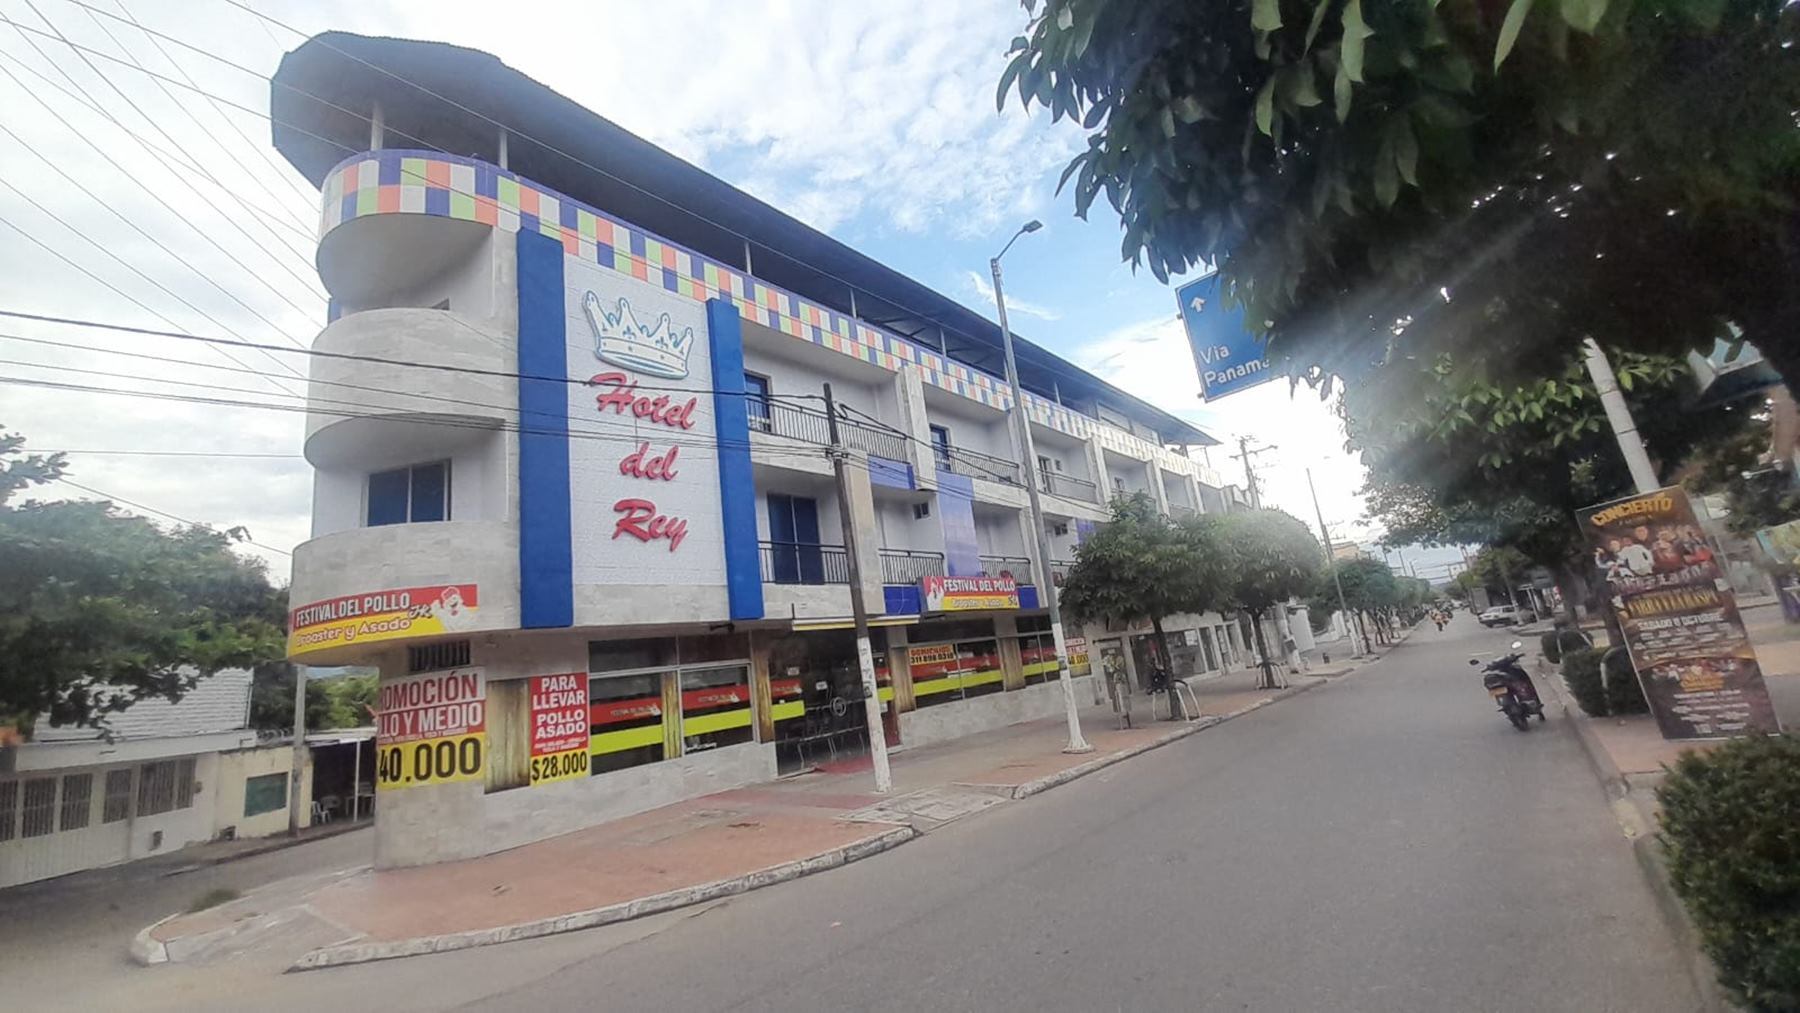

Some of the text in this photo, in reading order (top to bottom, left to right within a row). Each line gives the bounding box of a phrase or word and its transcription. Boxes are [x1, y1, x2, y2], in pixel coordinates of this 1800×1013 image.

[591, 372, 697, 430] Hotel
[619, 442, 680, 481] del
[612, 498, 689, 552] Rey
[943, 579, 1016, 592] FESTIVAL DEL POLLO
[296, 592, 410, 628] FESTIVAL DEL POLLO
[344, 626, 356, 642] y
[358, 616, 411, 636] Asado
[541, 675, 577, 693] PARA
[533, 690, 586, 711] LLEVAR
[403, 711, 416, 735] Y
[418, 702, 483, 733] MEDIO
[536, 721, 586, 740] ASADO
[537, 709, 585, 725] POLLO
[380, 737, 481, 783] 40.000
